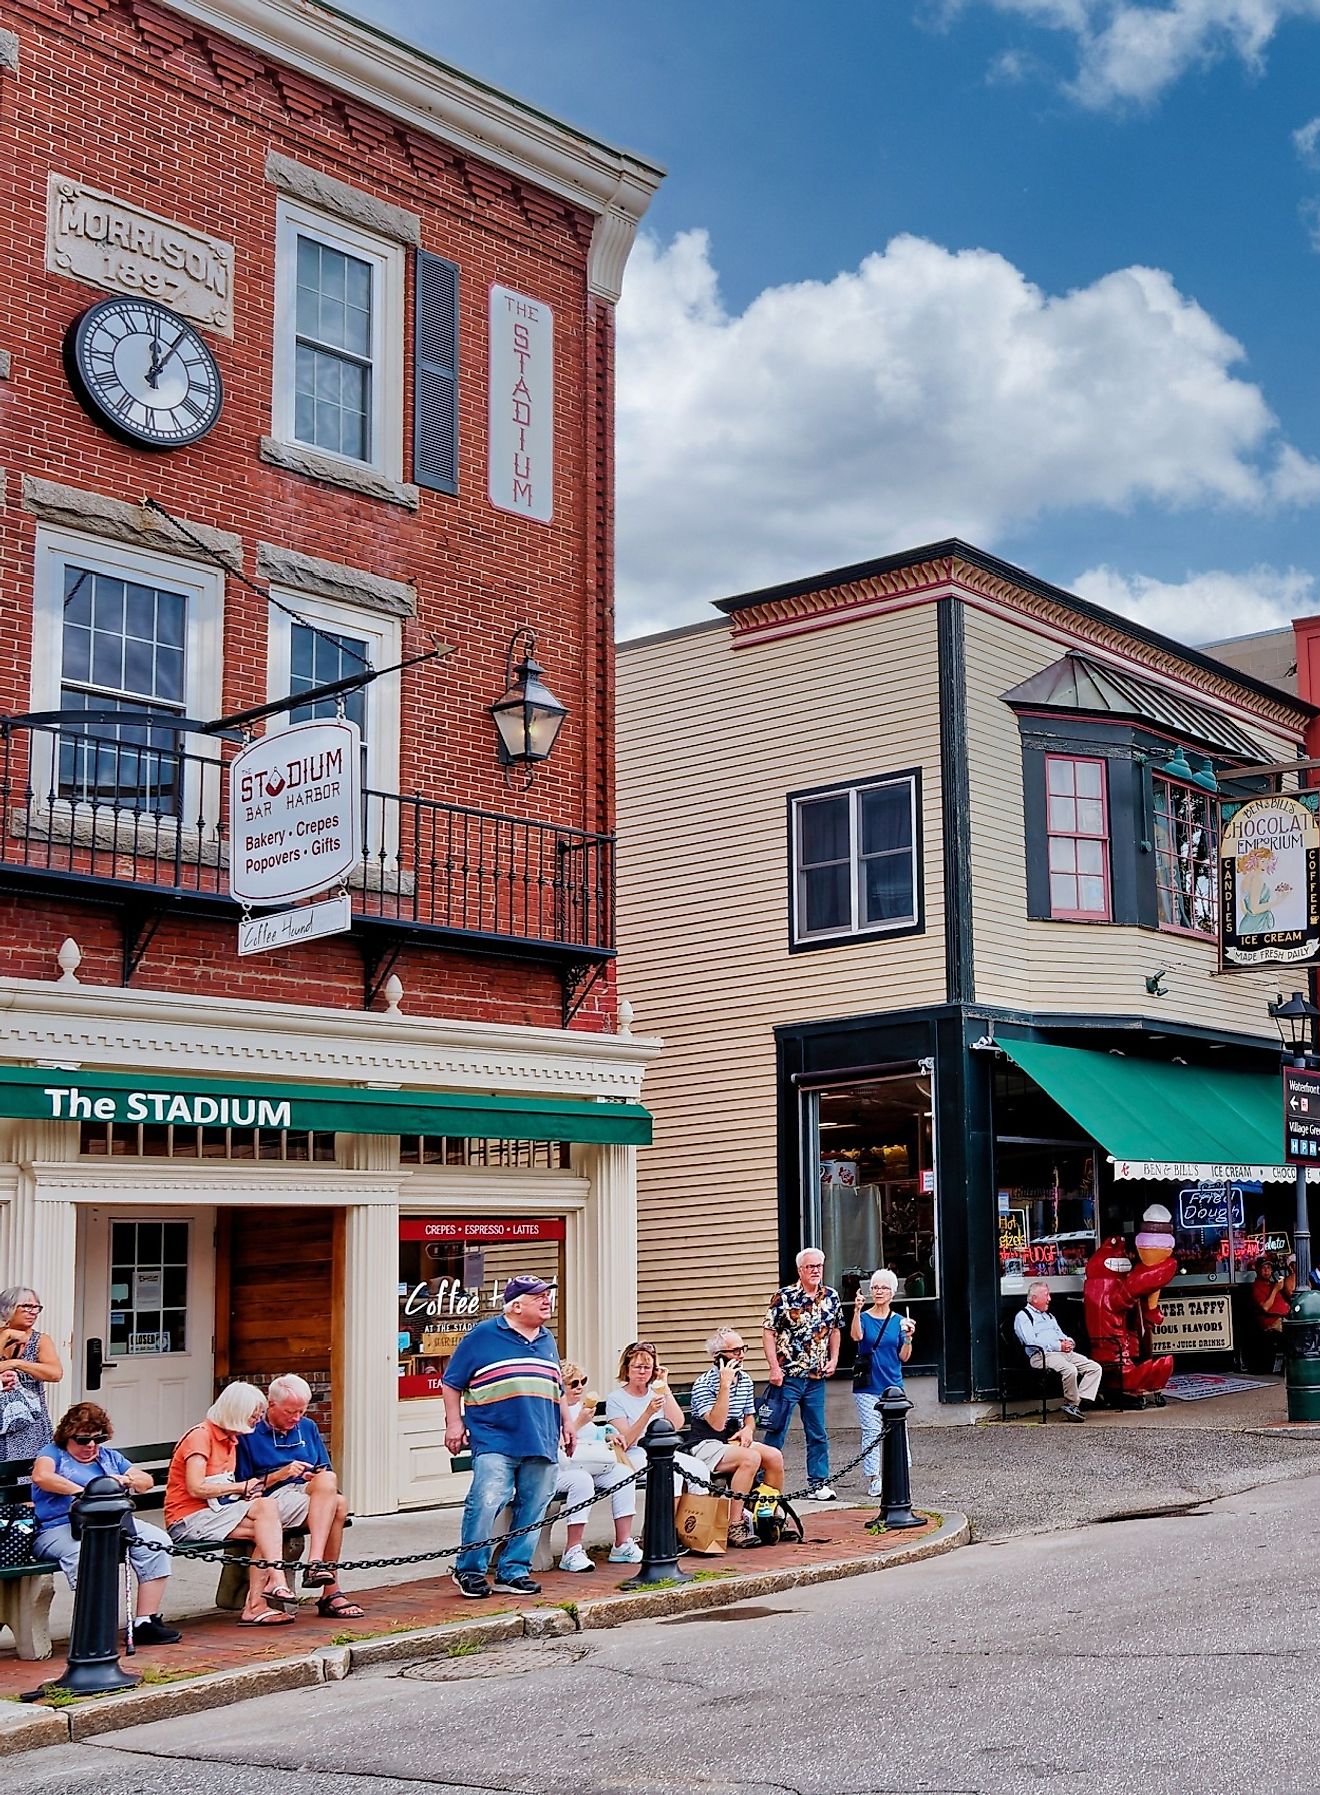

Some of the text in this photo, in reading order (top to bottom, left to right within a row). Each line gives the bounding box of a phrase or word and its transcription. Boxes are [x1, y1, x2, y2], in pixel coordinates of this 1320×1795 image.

[60, 199, 228, 299] MORRISON
[104, 256, 187, 303] 1897
[504, 296, 539, 322] THE
[512, 323, 532, 507] STADIUM
[245, 782, 340, 821] BAR HARBOR
[1243, 801, 1262, 819] BEN
[1271, 798, 1296, 814] BILL'S
[245, 815, 339, 851] Bakery Crepes
[1222, 812, 1320, 840] CHOCOLATE
[245, 836, 341, 874] Popovers Gifts
[1238, 834, 1304, 854] EMPORIUM
[1308, 850, 1318, 914] COFFEE
[1224, 860, 1233, 933] CANDIES
[244, 910, 314, 947] Coffee Hound
[1241, 931, 1302, 945] ICE CREAM
[1235, 947, 1310, 961] MADE FRESH DAILY
[1289, 1079, 1320, 1095] Waterfront
[44, 1087, 291, 1127] The STADIUM
[1289, 1121, 1309, 1136] Village
[1144, 1163, 1161, 1175] BEN
[1211, 1165, 1224, 1177] ICE
[1225, 1166, 1252, 1178] CREAM
[1184, 1205, 1240, 1222] Dough
[425, 1224, 539, 1235] CREPES ESPRESSO LATTES
[405, 1278, 480, 1316] Coffee
[1159, 1301, 1225, 1317] TER TAFFY
[424, 1323, 478, 1333] AT THE STAD
[1152, 1322, 1223, 1335] CIOUS FLAVORS
[1153, 1339, 1225, 1351] FFEE JUICE DRINKS
